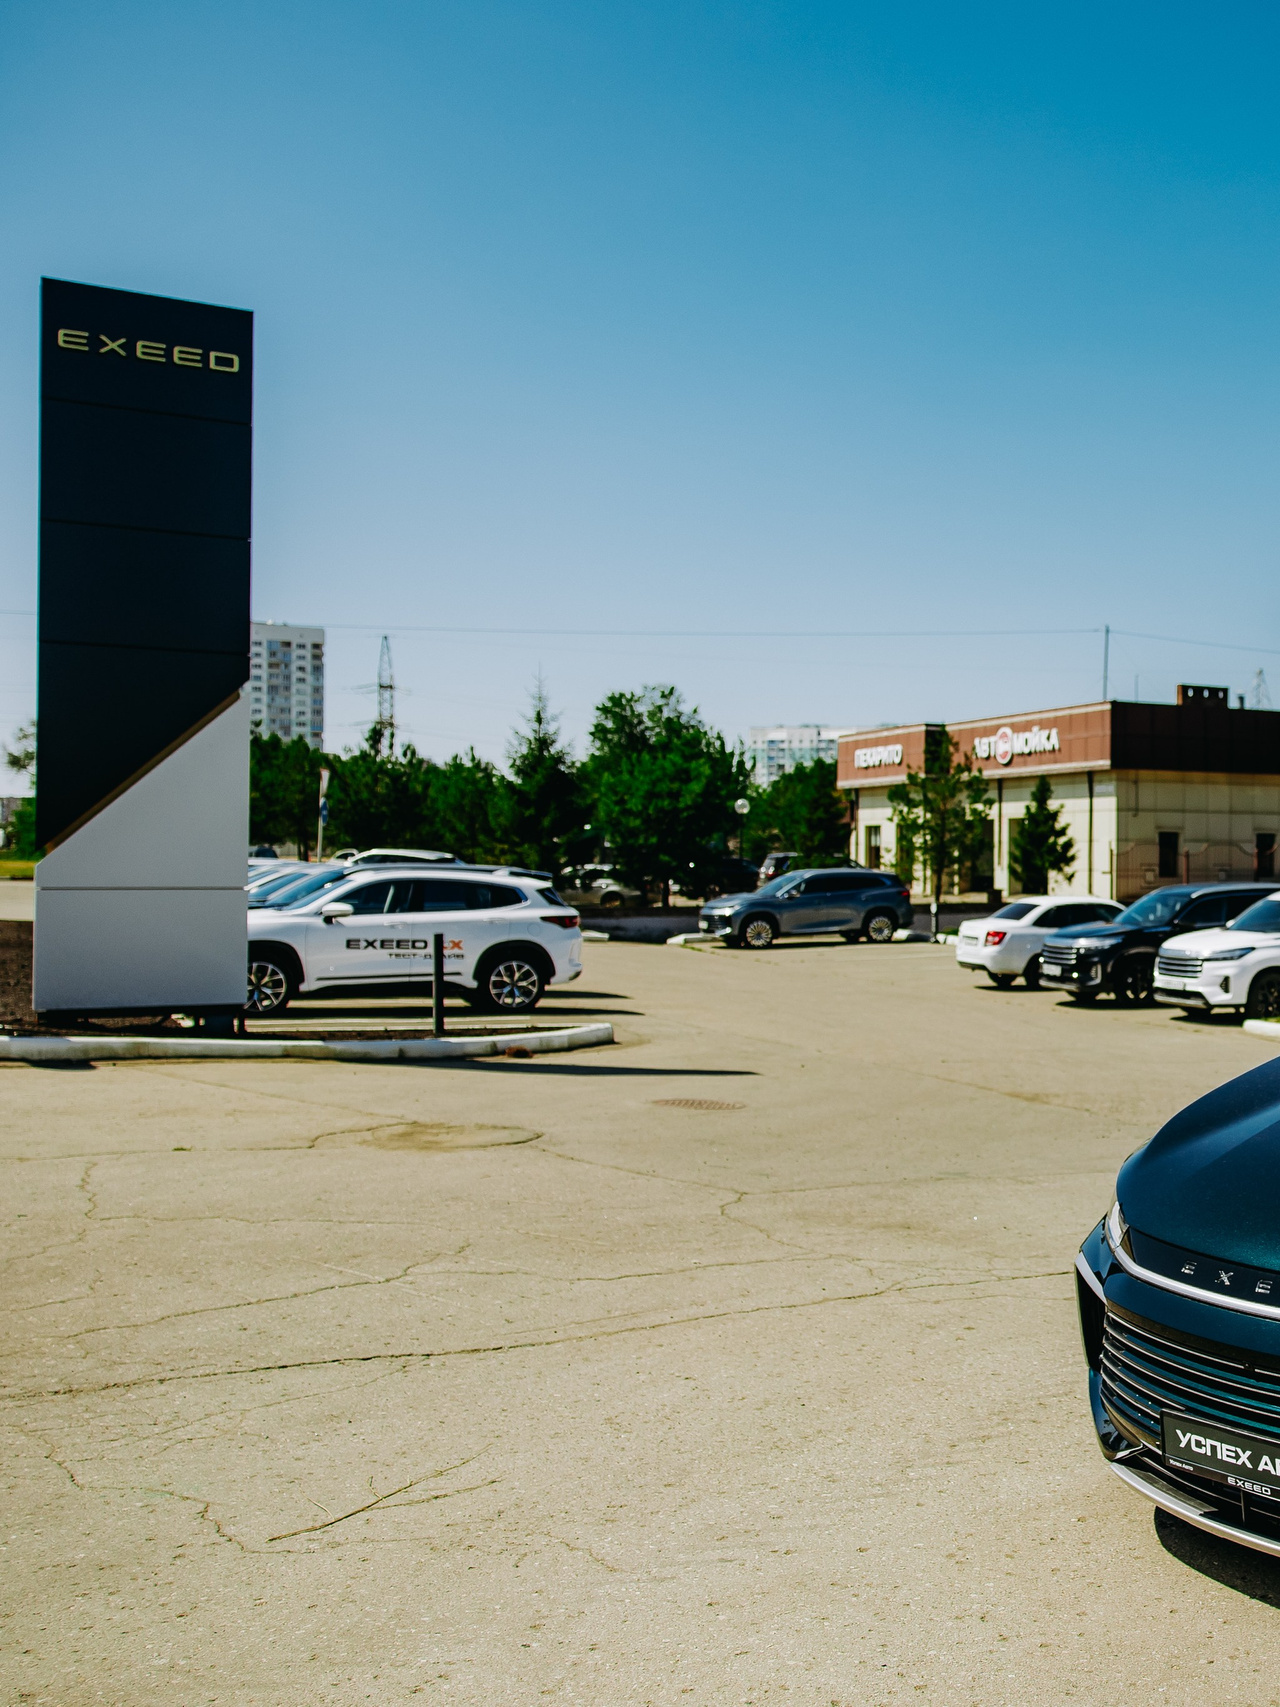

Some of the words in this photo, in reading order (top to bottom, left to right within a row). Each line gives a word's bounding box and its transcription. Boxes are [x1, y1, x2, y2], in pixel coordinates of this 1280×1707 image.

[57, 328, 240, 373] EXEED
[346, 939, 428, 950] EXEED
[1175, 1429, 1254, 1469] УСПЕХ
[1227, 1476, 1271, 1496] EXEED
